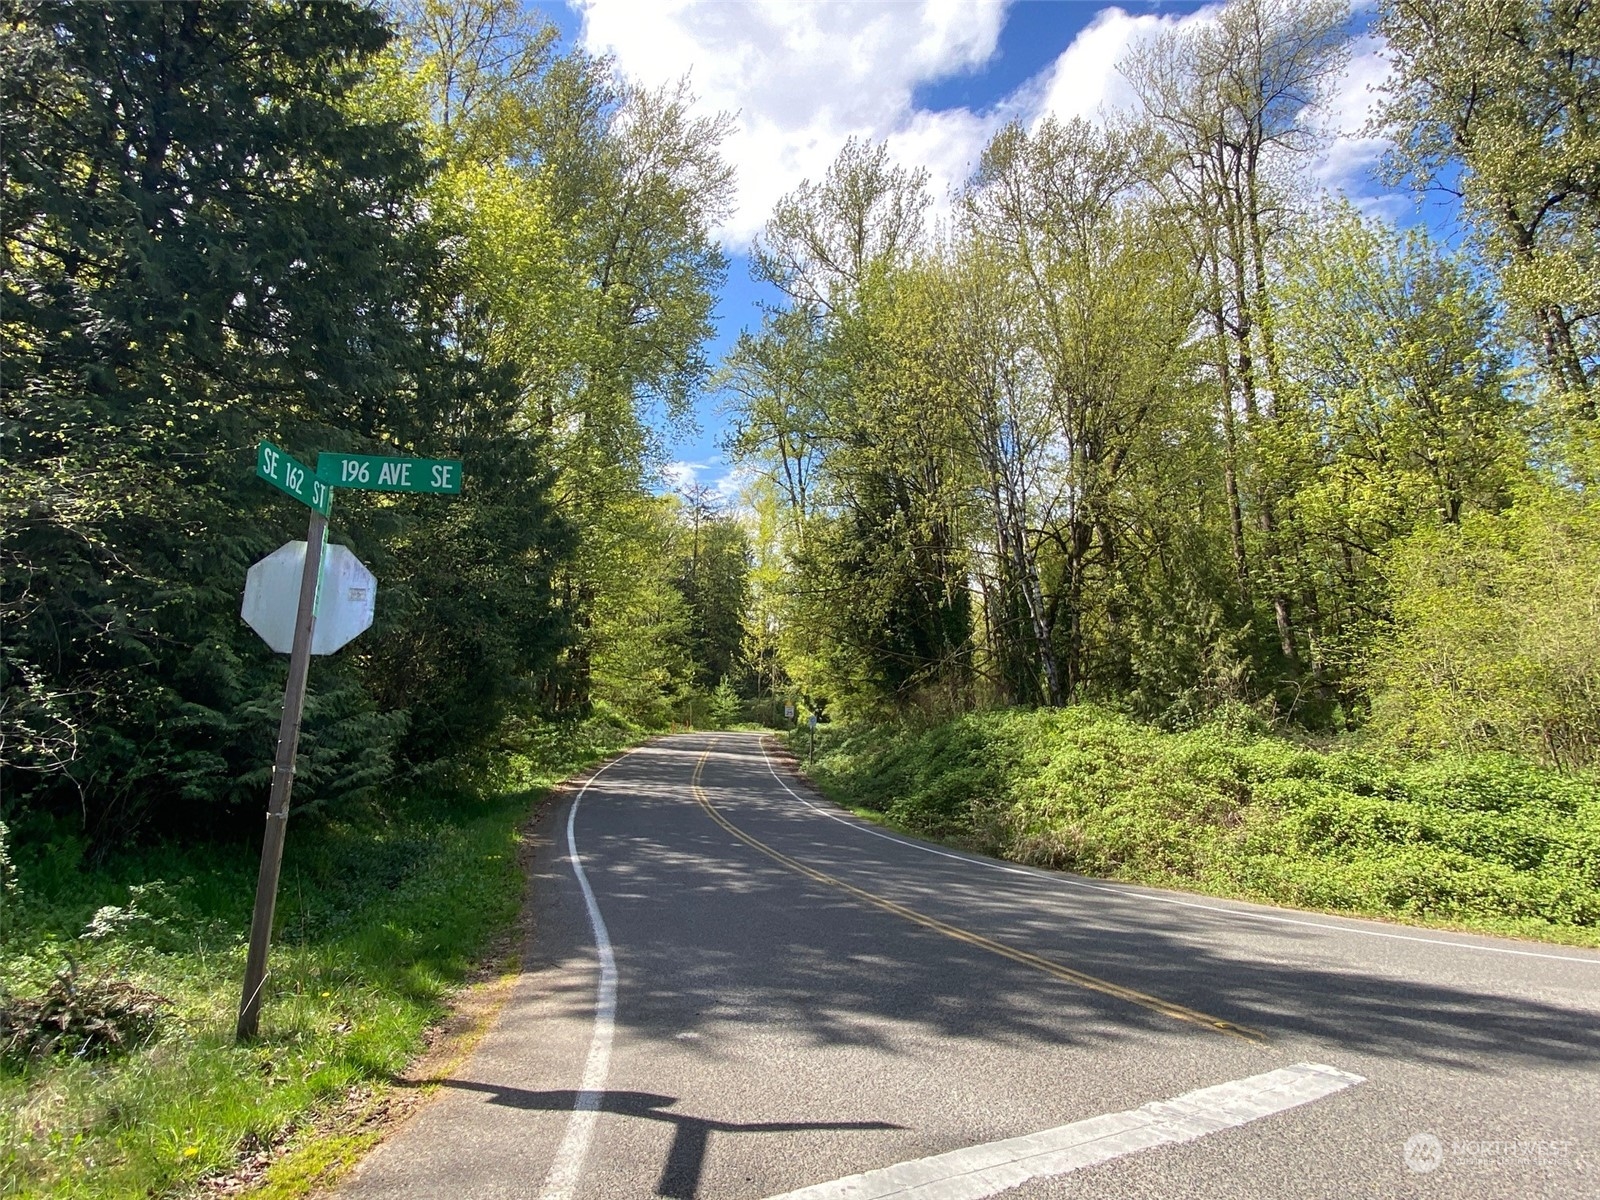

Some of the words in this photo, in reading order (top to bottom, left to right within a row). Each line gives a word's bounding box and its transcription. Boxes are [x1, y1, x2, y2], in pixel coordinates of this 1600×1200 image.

[263, 447, 279, 479] SE
[286, 462, 304, 494] 162
[312, 480, 326, 508] ST
[341, 460, 370, 483] 196
[378, 462, 412, 486] AVE
[431, 464, 453, 488] SE
